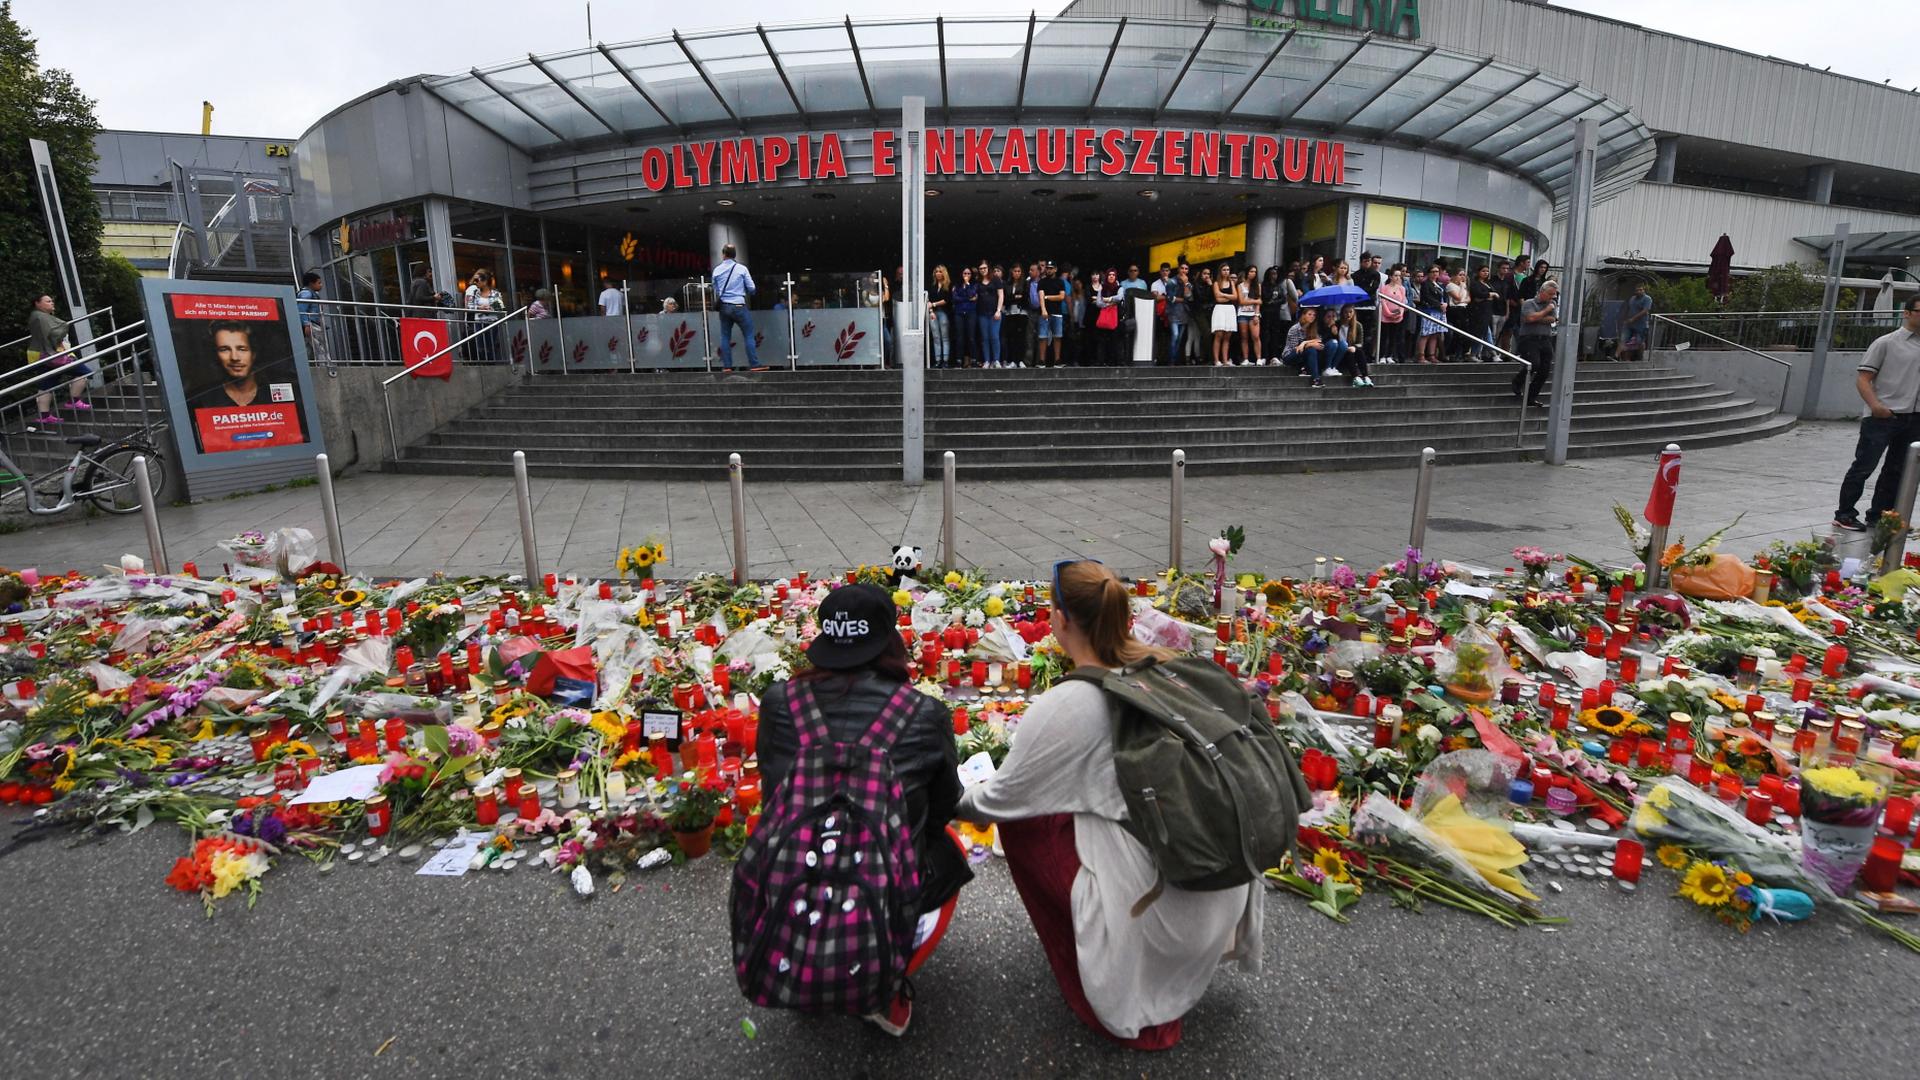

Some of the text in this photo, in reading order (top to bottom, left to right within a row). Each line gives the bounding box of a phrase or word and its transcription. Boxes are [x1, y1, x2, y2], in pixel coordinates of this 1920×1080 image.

[641, 127, 1345, 192] OLYMPIA ENKAUFSZENTRUM
[212, 412, 283, 425] PARSHIP.de
[822, 618, 870, 637] GIVES
